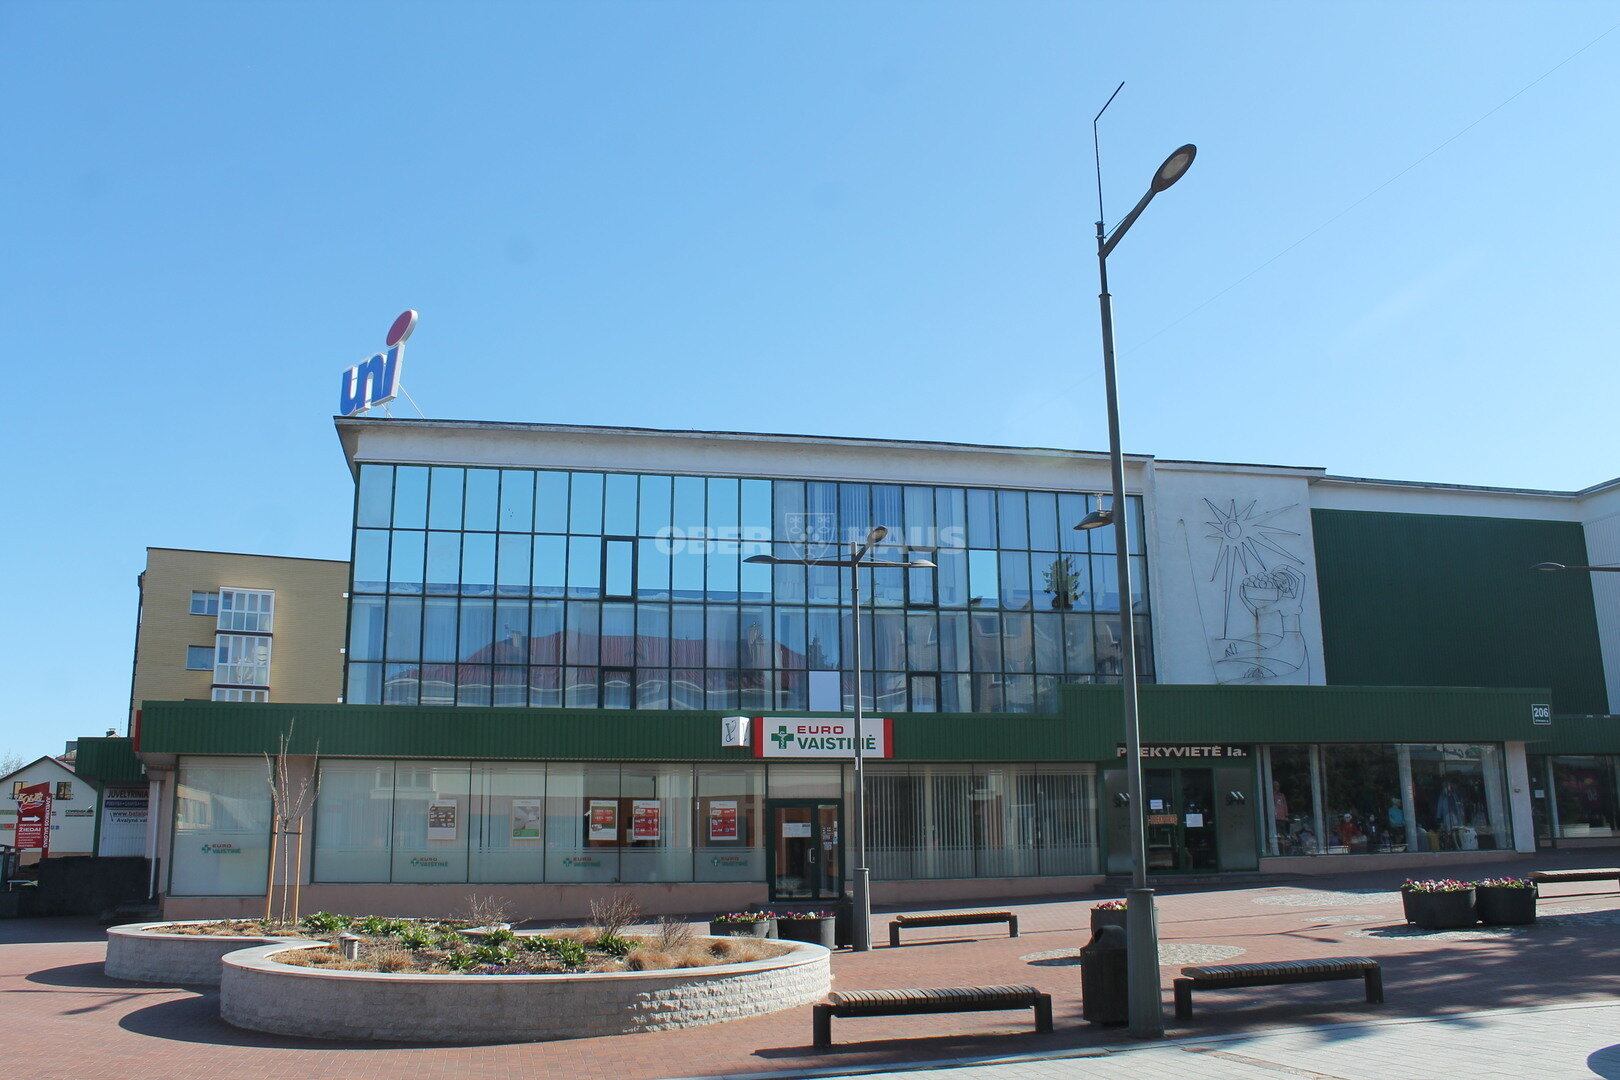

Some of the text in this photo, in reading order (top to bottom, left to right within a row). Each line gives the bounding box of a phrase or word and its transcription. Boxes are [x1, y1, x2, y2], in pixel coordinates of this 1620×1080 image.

[1533, 707, 1549, 718] 206
[797, 725, 844, 734] EURO
[1116, 745, 1222, 757] PEKYVIETĖ
